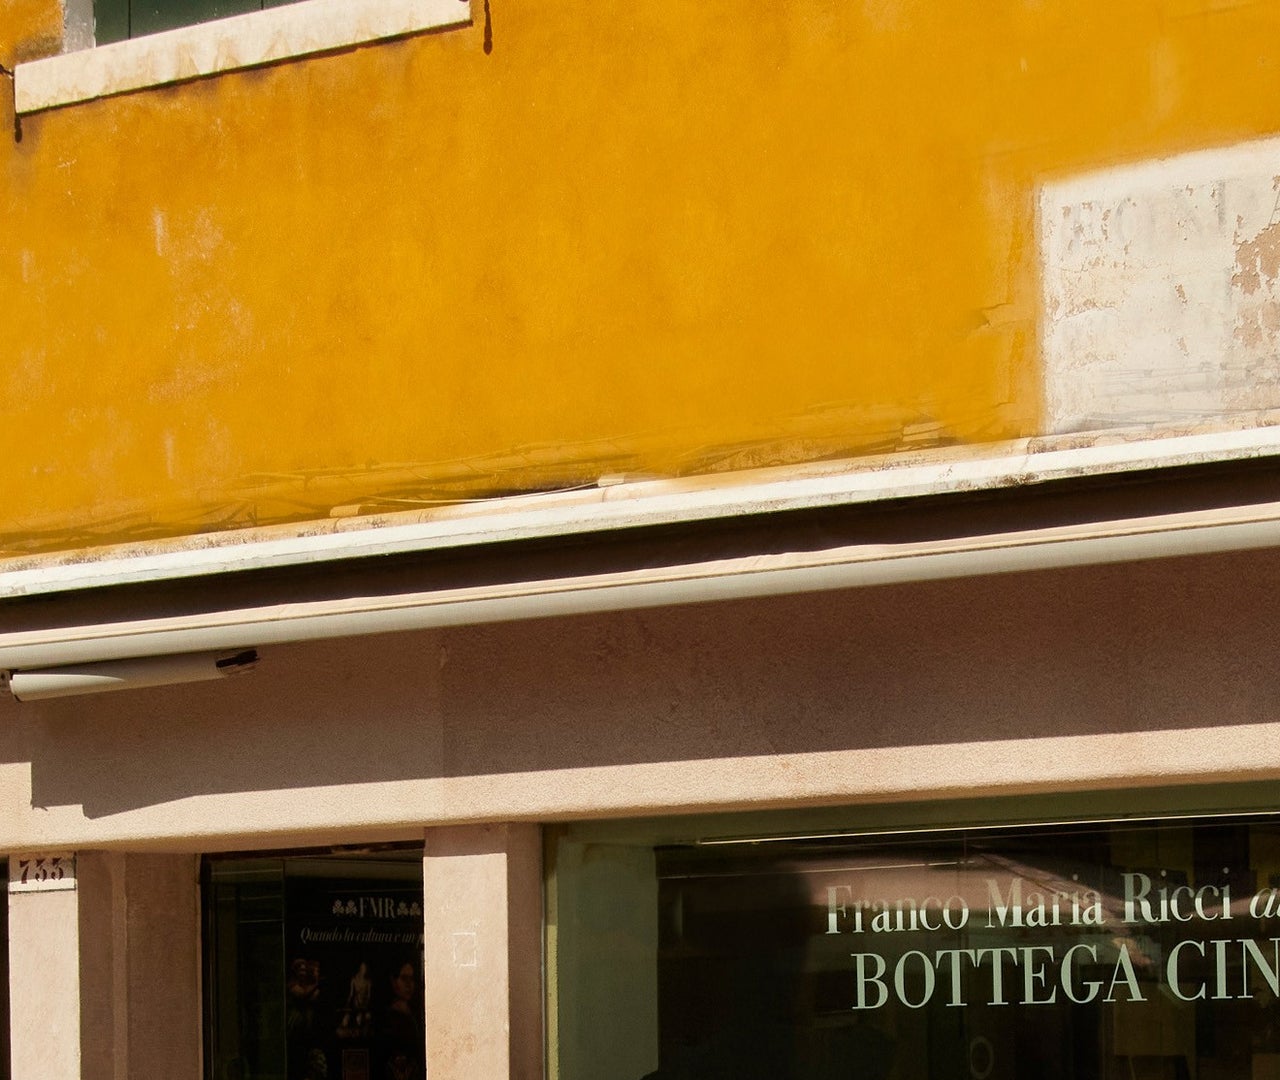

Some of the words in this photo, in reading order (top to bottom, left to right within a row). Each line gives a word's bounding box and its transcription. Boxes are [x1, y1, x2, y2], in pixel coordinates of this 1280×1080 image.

[359, 896, 396, 918] FMR
[824, 883, 971, 935] Franco
[985, 873, 1106, 929] Maria
[1120, 866, 1235, 924] Ricci
[850, 942, 1149, 1010] BOTTEGA
